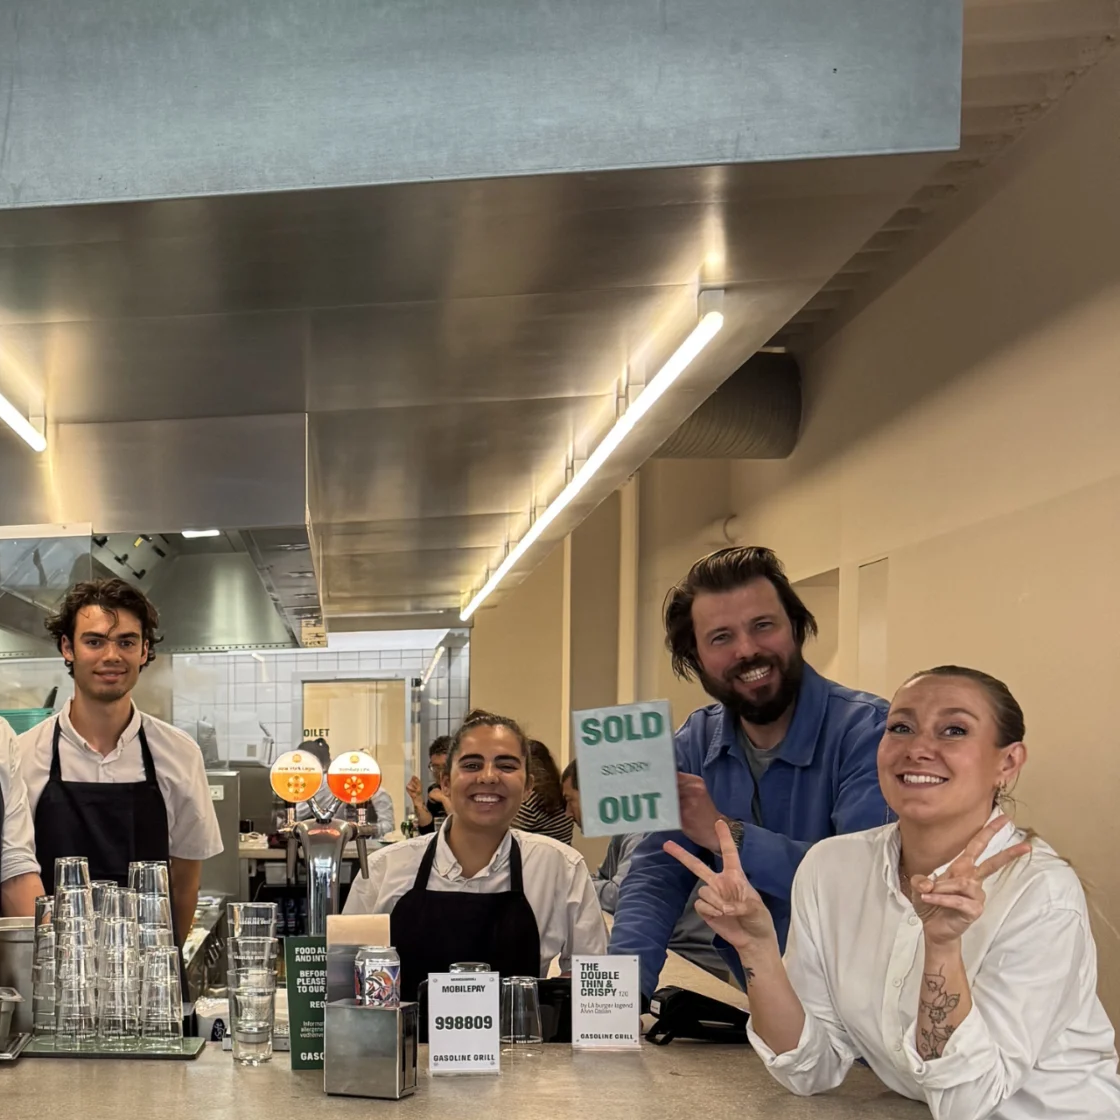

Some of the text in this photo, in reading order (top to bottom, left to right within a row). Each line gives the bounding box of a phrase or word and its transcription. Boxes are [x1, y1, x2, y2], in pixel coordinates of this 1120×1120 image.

[303, 728, 330, 738] OILET
[581, 711, 664, 746] SOLD
[598, 792, 662, 825] OUT
[294, 946, 327, 955] FOOD AL
[580, 963, 599, 971] THE
[580, 971, 620, 980] DOUBLE
[296, 978, 326, 986] PLEASE
[580, 980, 613, 988] THIN &
[442, 985, 486, 993] MOBILEPAY
[580, 988, 617, 997] CRISPY
[435, 1015, 493, 1030] 998809
[433, 1054, 471, 1062] GASOLINE
